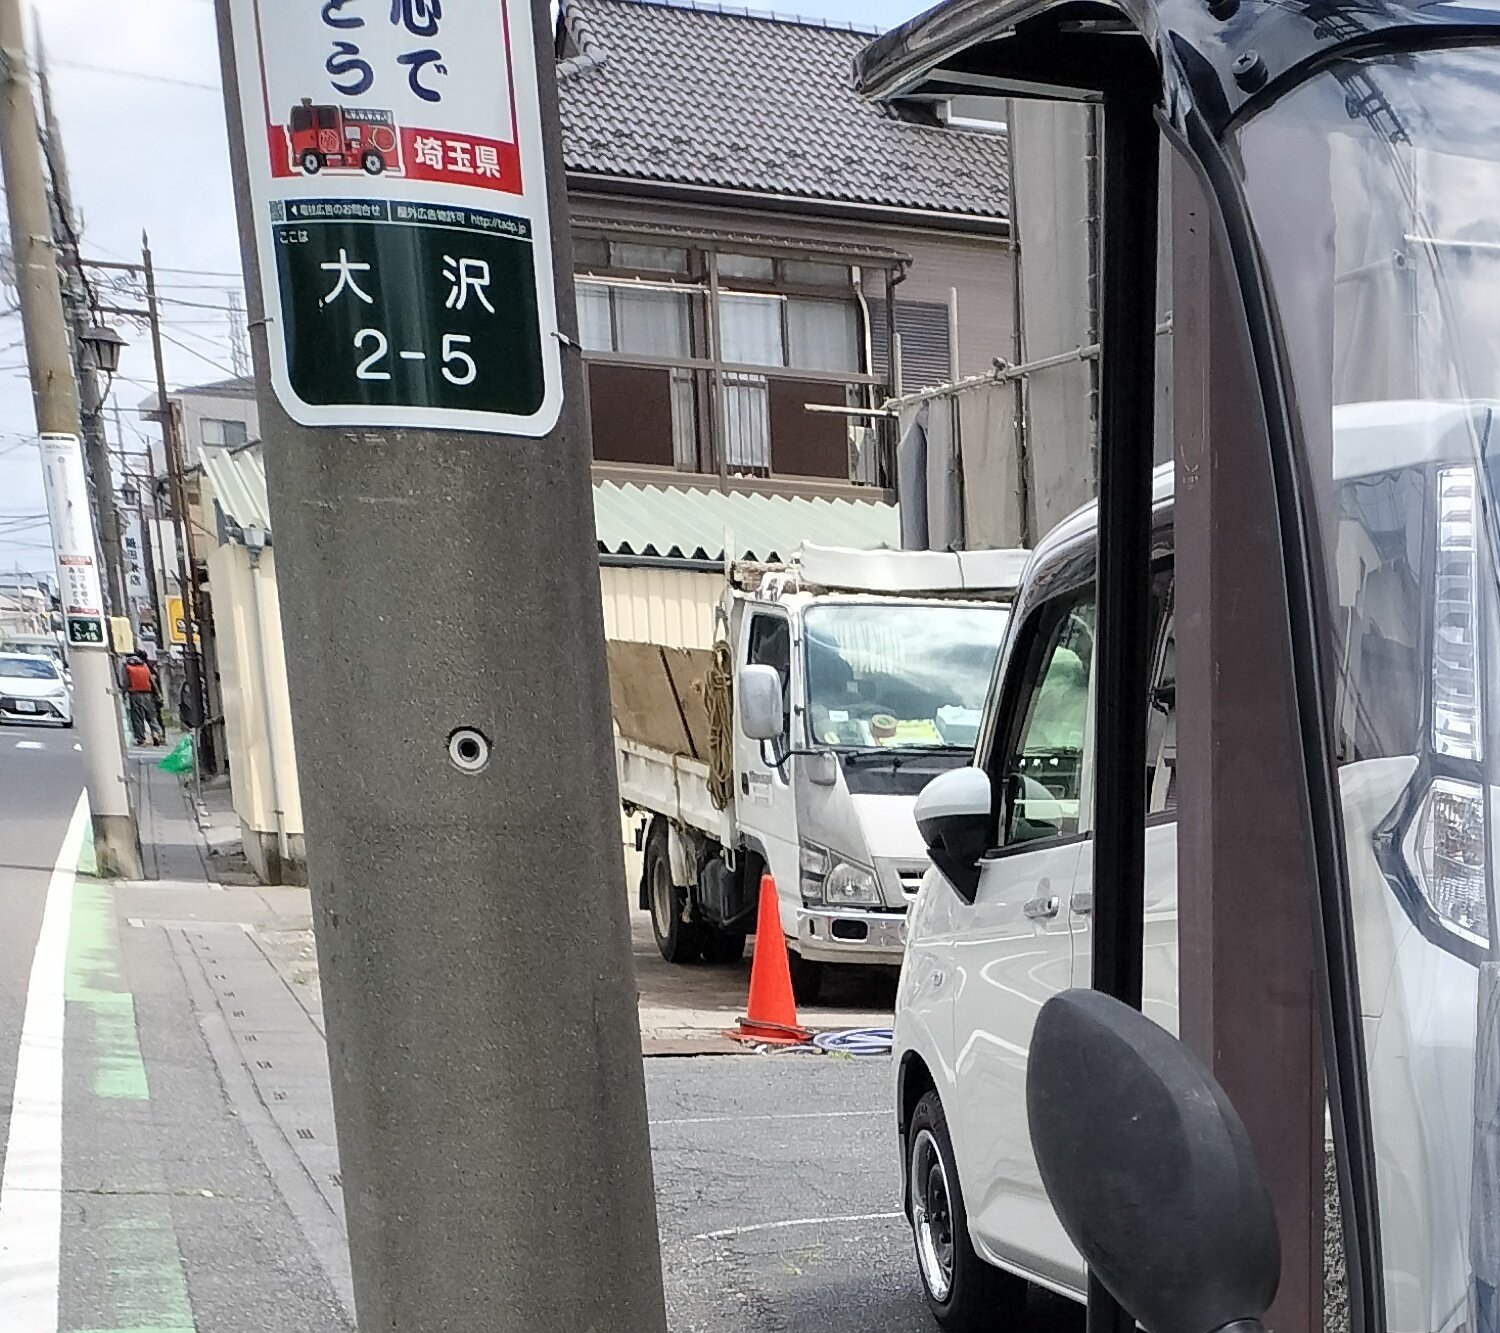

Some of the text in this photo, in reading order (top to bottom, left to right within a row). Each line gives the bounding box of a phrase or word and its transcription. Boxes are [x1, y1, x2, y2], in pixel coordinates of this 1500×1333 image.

[413, 135, 501, 179] 埼玉県
[279, 230, 309, 244] ここは
[320, 248, 495, 314] 大沢
[353, 328, 477, 386] 2-5
